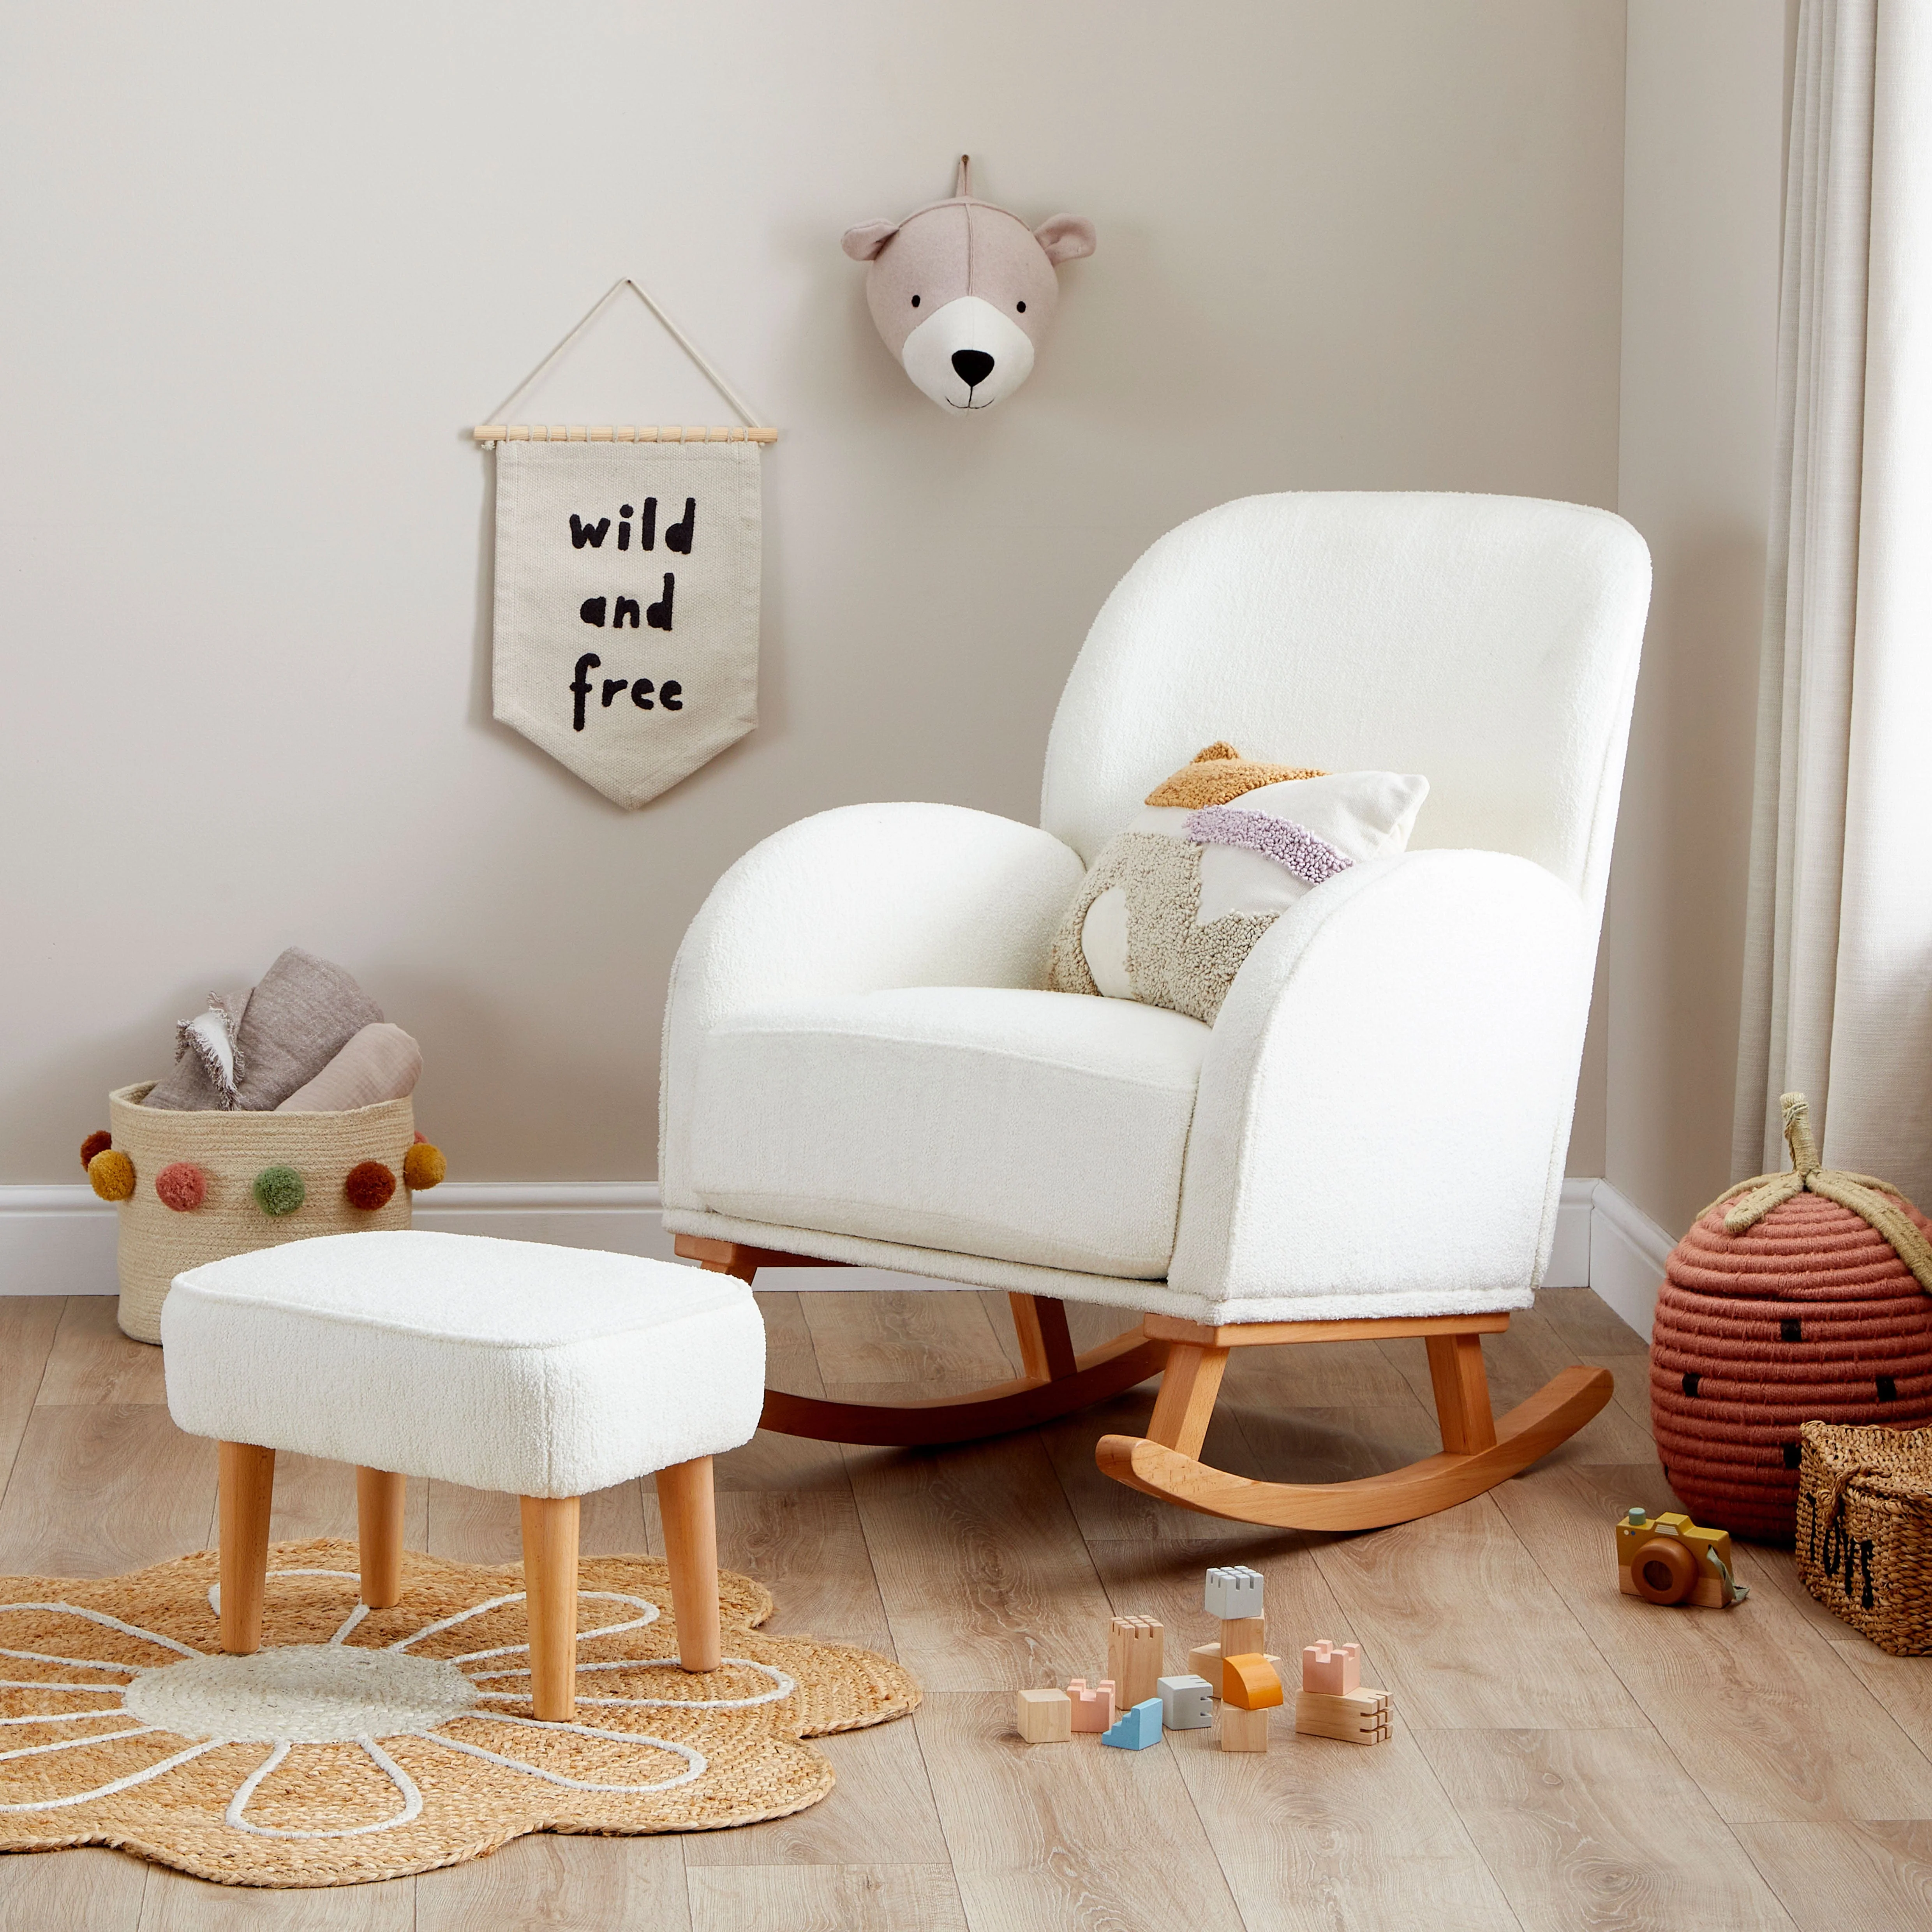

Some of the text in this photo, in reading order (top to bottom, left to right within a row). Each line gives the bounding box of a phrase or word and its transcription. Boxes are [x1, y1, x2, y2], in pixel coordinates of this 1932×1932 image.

[569, 497, 696, 555] wild
[580, 573, 675, 631] and
[569, 653, 683, 732] free
